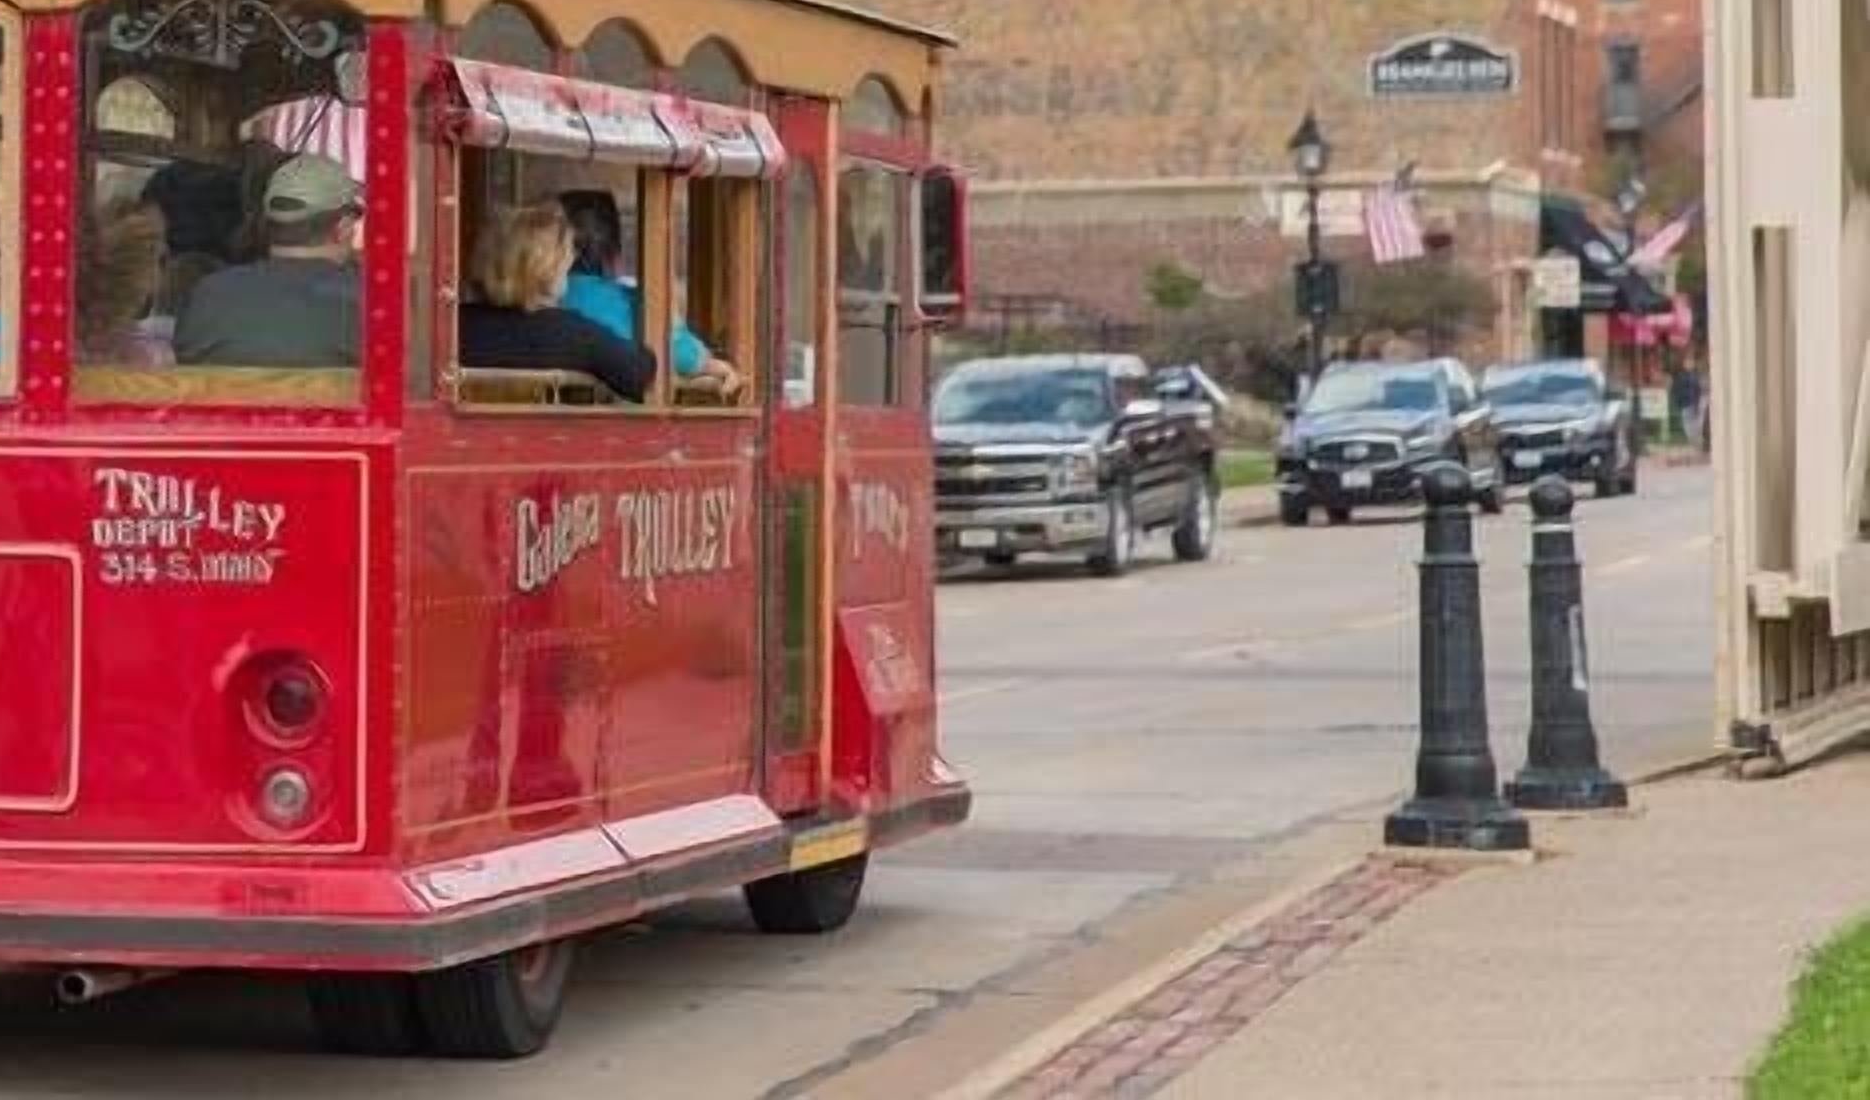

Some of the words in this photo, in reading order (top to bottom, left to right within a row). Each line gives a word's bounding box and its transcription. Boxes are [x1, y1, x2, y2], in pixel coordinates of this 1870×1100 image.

[94, 468, 286, 541] TROLLEY
[92, 516, 193, 548] DEPOT
[616, 486, 736, 604] TROLLEY
[100, 552, 157, 584] 314
